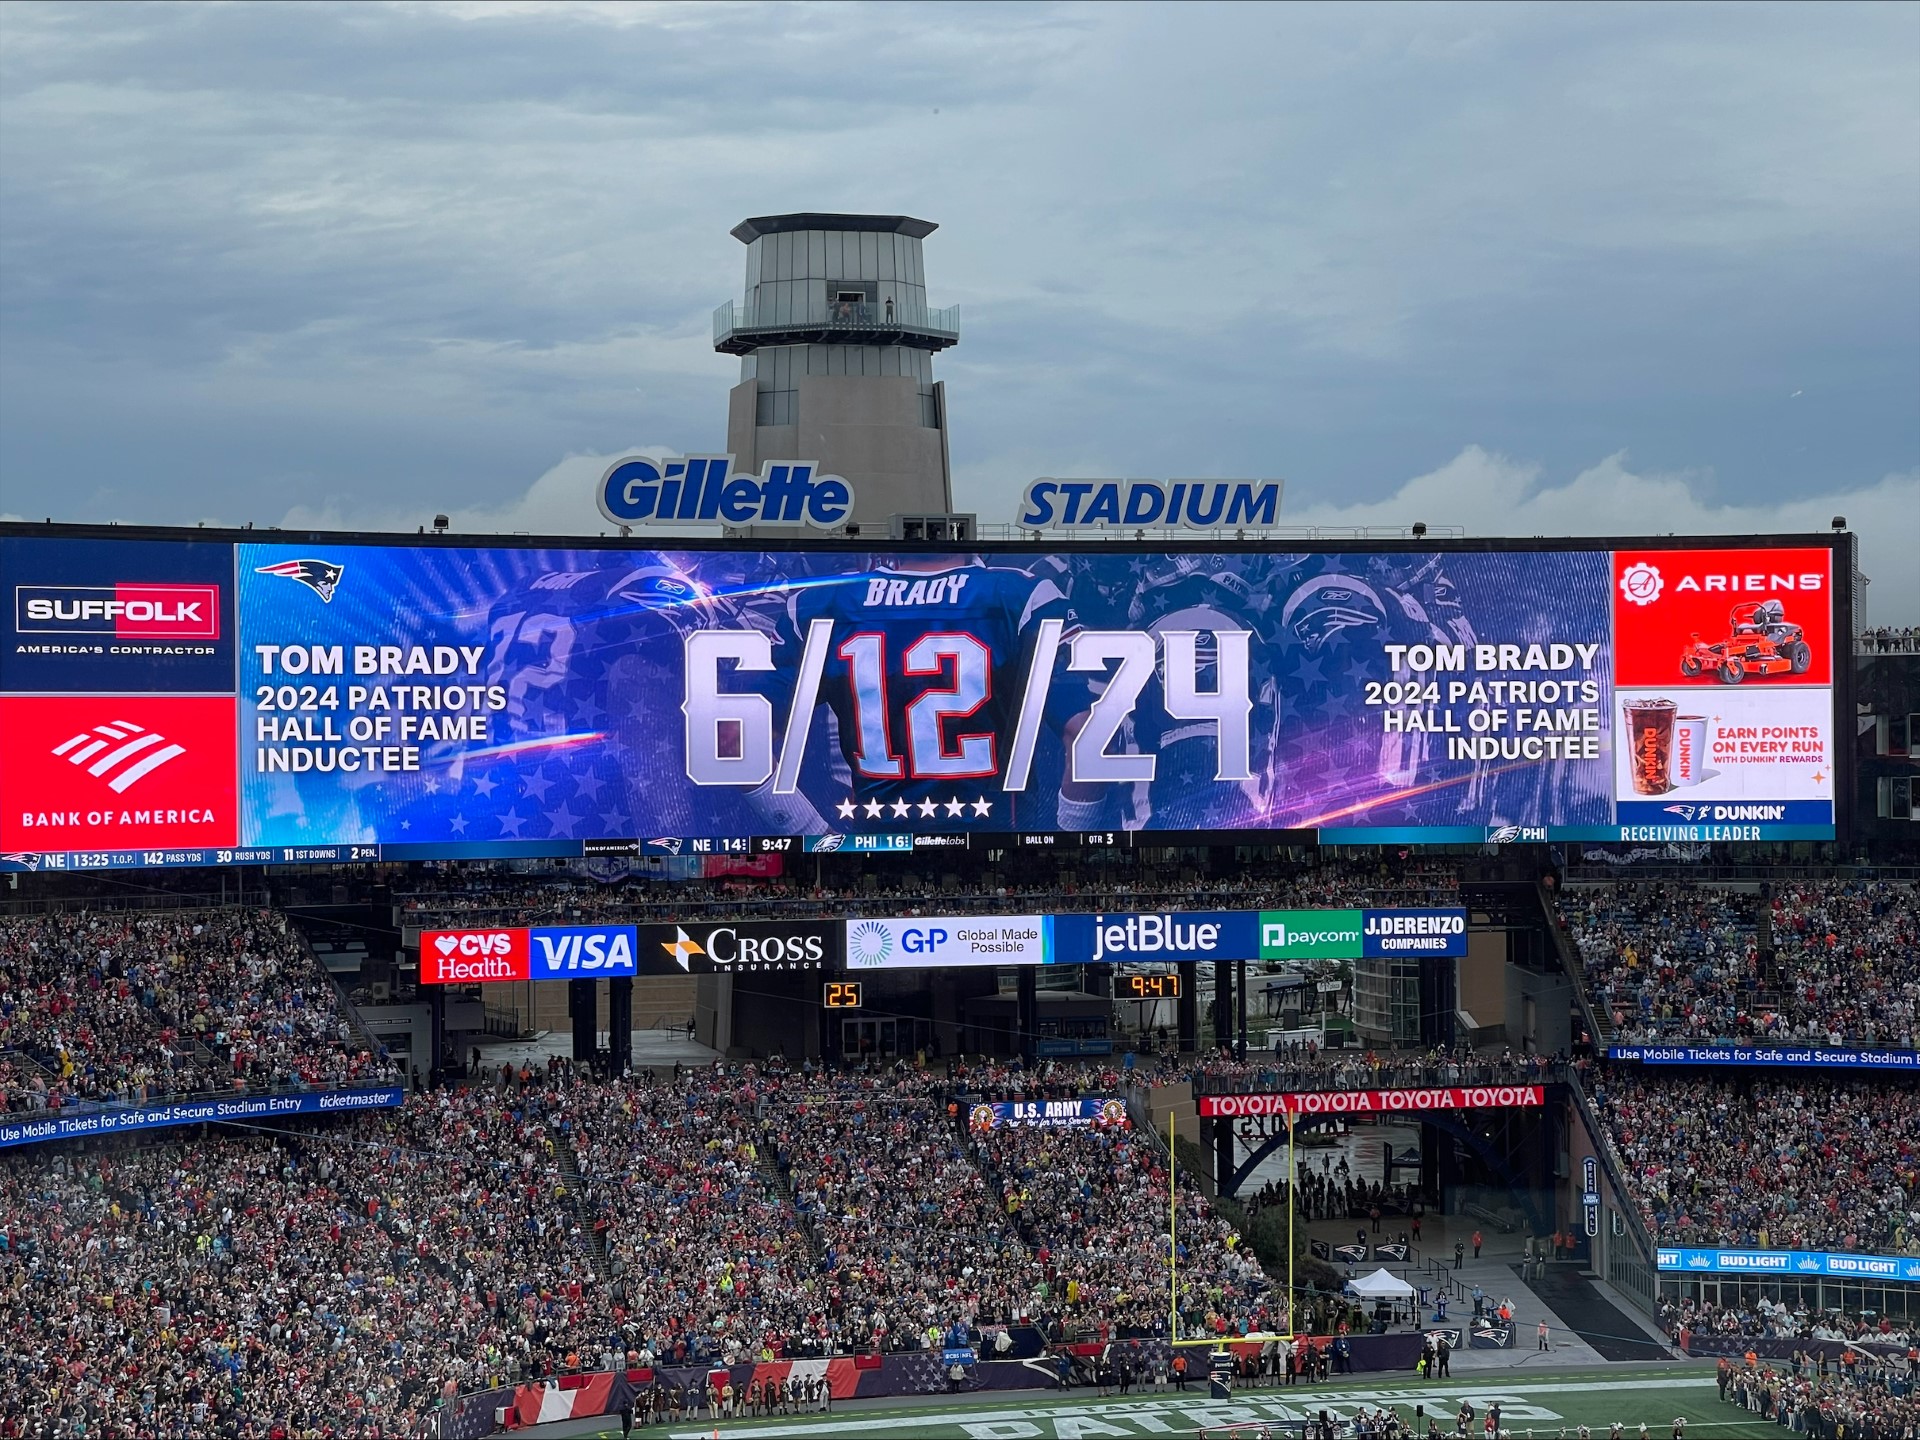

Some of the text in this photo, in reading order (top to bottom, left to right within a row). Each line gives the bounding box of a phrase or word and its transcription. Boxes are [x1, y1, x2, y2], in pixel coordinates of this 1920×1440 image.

[604, 463, 853, 524] Gillette
[1023, 481, 1281, 526] STADIUM
[863, 574, 969, 606] BRADY
[1675, 574, 1822, 592] ARIENS
[27, 600, 203, 622] SUFFOLK
[16, 645, 215, 655] AMERICA'S CONTRACTOR
[1384, 643, 1599, 671] TOM BRADY
[255, 646, 485, 675] TOM BRADY
[256, 686, 508, 711] 2024 PATRIOTS
[1364, 680, 1600, 704] 2024 PATRIOTS
[1384, 708, 1599, 732] HALL OF FAME
[257, 716, 488, 742] HALL OF FAME
[1717, 727, 1818, 739] EARN POINTS
[1449, 737, 1599, 760] INDUCTEE
[1679, 728, 1691, 780] DUNKIN'
[1713, 741, 1823, 753] ON EVERY RUN
[257, 747, 421, 772] INDUCTEE
[1780, 755, 1823, 763] REWARDS
[22, 809, 215, 827] BANK OF AMERICA
[1715, 806, 1785, 820] DUNKIN'
[1026, 836, 1054, 845] BALL ON
[1089, 834, 1114, 845] QTR 3
[1522, 828, 1545, 841] PHI
[1621, 826, 1760, 841] RECEIVING LEADER
[693, 839, 711, 851] NE
[723, 838, 740, 851] 14
[762, 839, 791, 850] 9:47
[855, 836, 876, 848] PHI
[887, 836, 904, 848] 16
[73, 853, 135, 867] 13:25 T.O.P.
[143, 852, 202, 865] 142 PASS YDS
[216, 850, 271, 863] 30 RUSH YDS
[283, 849, 336, 861] 11 1ST DOWNS
[351, 847, 377, 859] 2 PEN.
[45, 854, 65, 868] NE
[1364, 917, 1464, 935] J.DERENZO
[957, 928, 1038, 941] Global Made
[1093, 915, 1219, 961] jetBlue
[1287, 931, 1356, 946] paycom
[461, 934, 512, 955] CVS
[971, 941, 1025, 953] Possible
[1381, 938, 1447, 950] COMPANIES
[534, 934, 634, 970] VISA
[437, 957, 512, 979] Health
[713, 961, 822, 972] INSURANCE
[1131, 976, 1178, 997] 9:47
[829, 984, 857, 1006] 25
[1617, 1049, 1639, 1059] Use
[1643, 1049, 1684, 1060] Mobile
[1688, 1049, 1730, 1060] Tickets
[1734, 1049, 1751, 1060] for
[1755, 1050, 1783, 1061] Safe
[1786, 1051, 1811, 1062] and
[1815, 1051, 1857, 1062] Secure
[1860, 1052, 1913, 1065] Stadium
[1209, 1088, 1538, 1115] TOYOTA TOYOTA TOYOTA TOYOTA
[1, 1093, 391, 1141] Use Mobile Tickets for Safe and Secure Stadium Entry ticketmaster
[1014, 1101, 1082, 1118] U.S. ARMY
[1039, 1119, 1050, 1128] for
[1720, 1256, 1787, 1267] BUD LIGHT
[1830, 1259, 1897, 1273] BUD LIGHT
[1079, 1400, 1206, 1413] TAKES
[1227, 1395, 1298, 1403] ALL
[1312, 1391, 1359, 1399] OF
[1379, 1389, 1426, 1398] US
